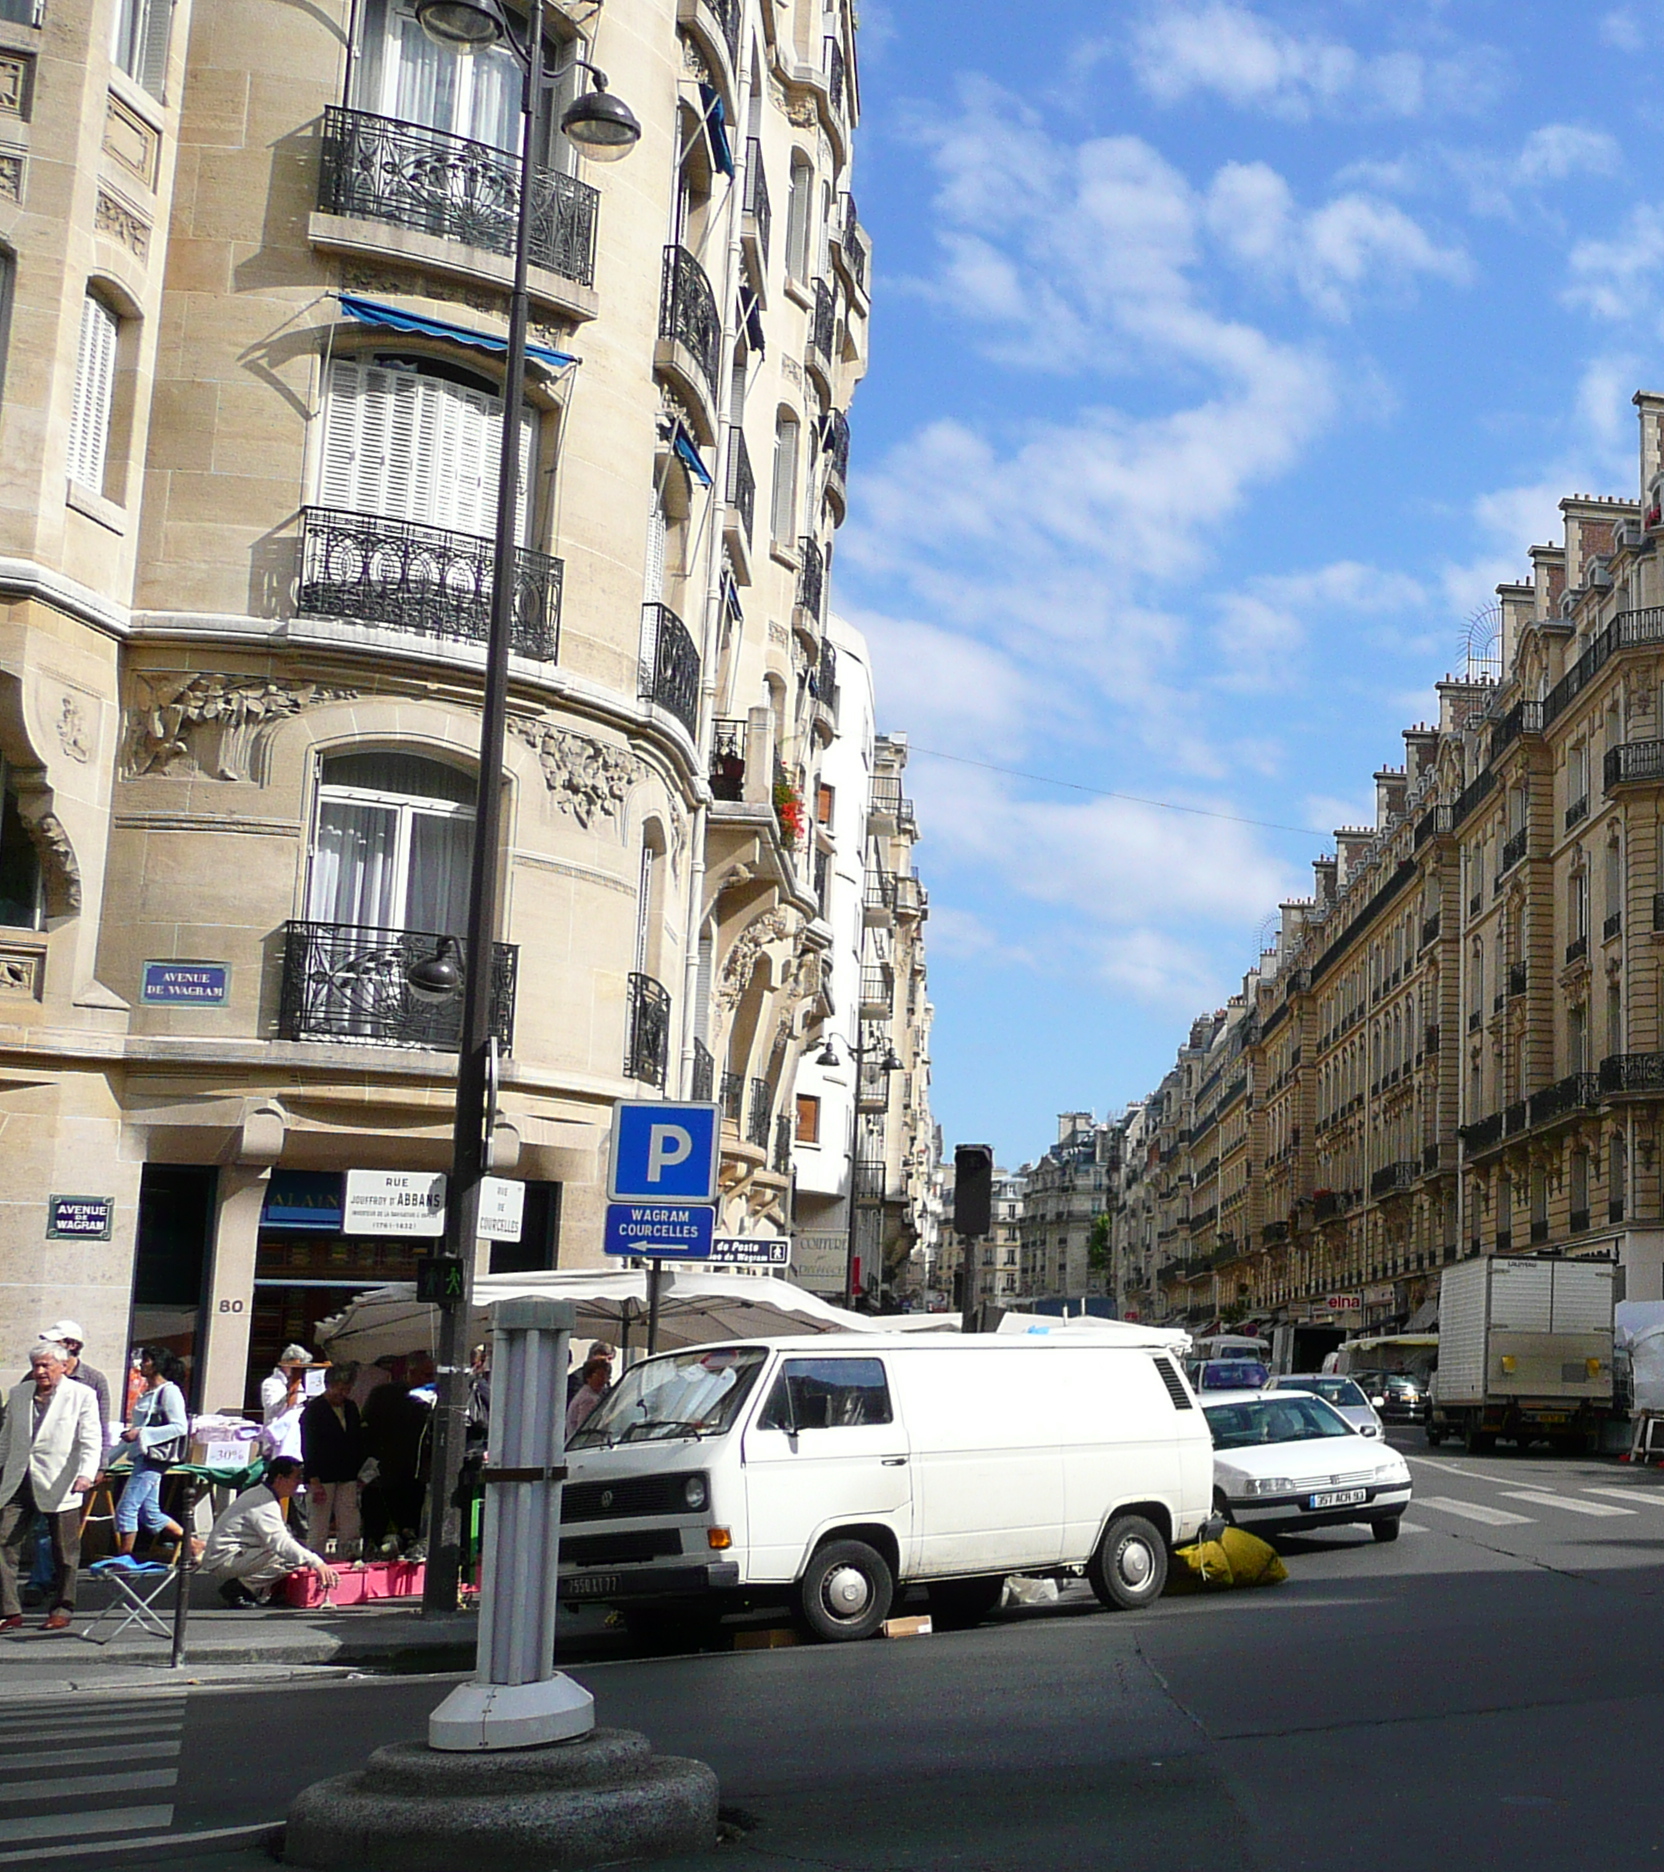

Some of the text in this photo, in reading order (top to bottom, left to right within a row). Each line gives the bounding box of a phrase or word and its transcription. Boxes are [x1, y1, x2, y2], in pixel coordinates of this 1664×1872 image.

[163, 972, 211, 984] AVENUE
[146, 985, 223, 997] DE WAGRAM
[647, 1123, 693, 1183] P
[386, 1177, 409, 1187] RUE
[57, 1204, 107, 1216] AVENUE
[632, 1209, 689, 1222] WAGRAM
[56, 1219, 105, 1230] WAGRAM
[480, 1216, 519, 1234] COURCELLES
[619, 1224, 698, 1237] COURCELLES
[219, 1300, 243, 1313] 80
[1328, 1296, 1360, 1308] elna
